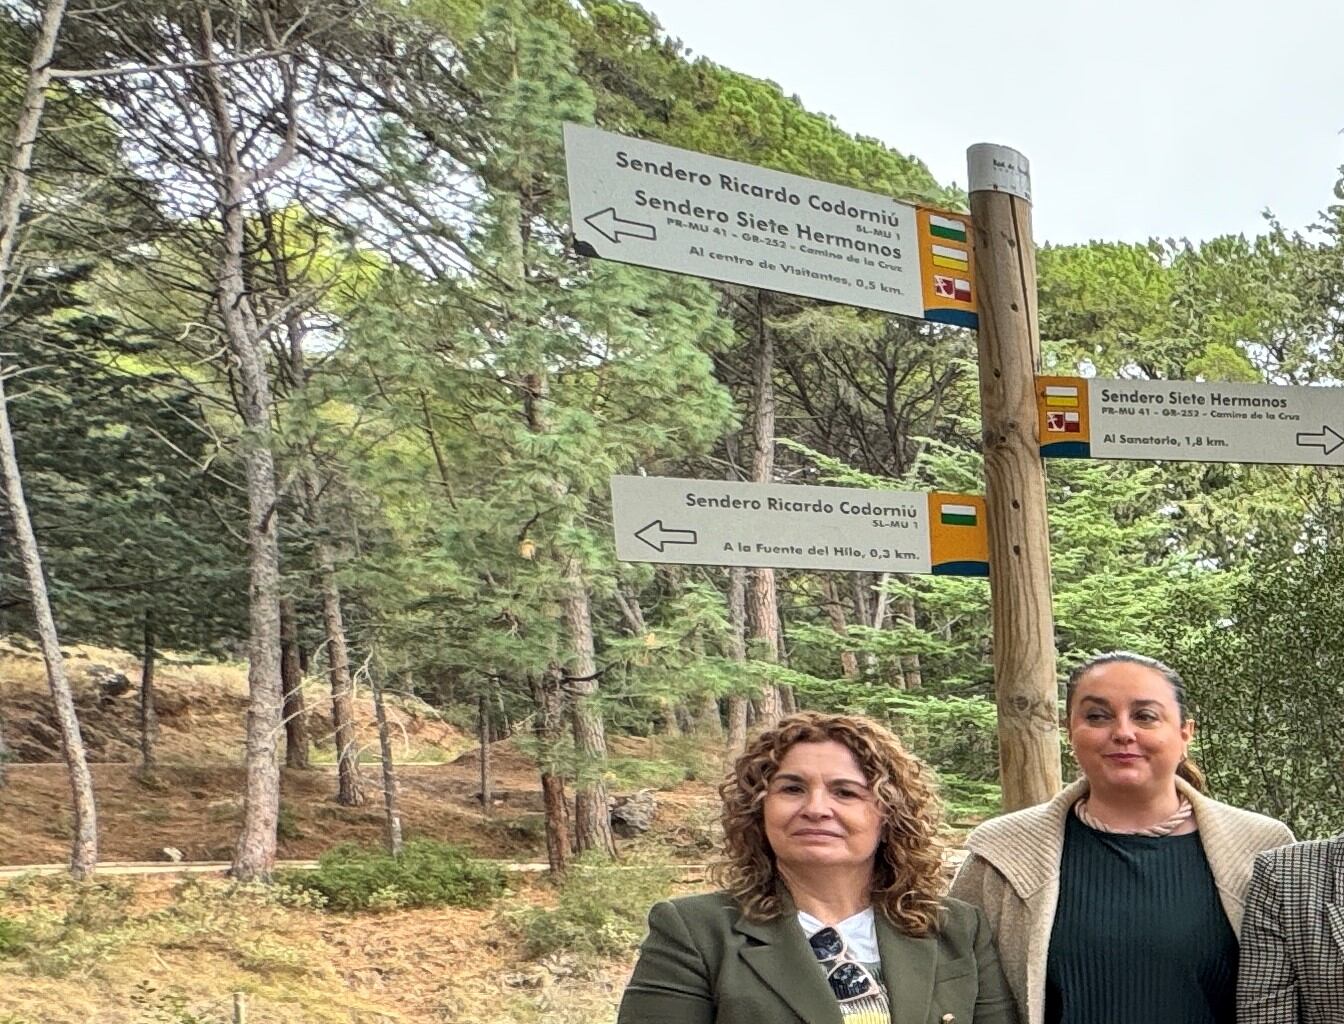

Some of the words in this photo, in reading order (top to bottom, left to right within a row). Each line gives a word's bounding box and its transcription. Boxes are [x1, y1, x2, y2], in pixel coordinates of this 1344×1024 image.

[616, 151, 712, 186] Sendero
[719, 173, 800, 207] Ricardo
[808, 195, 899, 227] Codorniú
[634, 189, 729, 223] Sendero
[736, 210, 789, 236] Siete
[796, 223, 902, 259] Hermanos
[667, 217, 709, 233] PR-MU
[713, 227, 727, 237] 41
[742, 232, 787, 249] GR-252
[799, 244, 843, 260] Camino
[846, 254, 860, 264] de
[864, 257, 875, 267] la
[878, 261, 903, 273] Cruz
[896, 232, 901, 241] 1
[689, 246, 704, 257] Al
[709, 251, 754, 266] centro
[758, 260, 776, 271] de
[780, 263, 852, 287] Visitantes,
[855, 279, 875, 291] 0,5
[880, 283, 904, 296] km.
[1101, 389, 1164, 404] Sendero
[1169, 391, 1206, 405] Siete
[1210, 393, 1287, 408] Hermanos
[1101, 407, 1135, 415] PR-MU
[1138, 408, 1150, 416] 41
[1162, 408, 1199, 417] GR-252
[1210, 410, 1247, 419] Camino
[1250, 411, 1263, 419] de
[1266, 412, 1275, 420] la
[1278, 412, 1300, 421] Cruz
[1103, 434, 1116, 443] Al
[1119, 434, 1181, 447] Sanatorio,
[1185, 436, 1203, 447] 1,8
[1206, 436, 1229, 447] km.
[686, 493, 761, 510] Sendero
[767, 497, 834, 513] Ricardo
[839, 501, 917, 518] Codorniú
[872, 520, 909, 529] SL-MU
[913, 521, 919, 529] 1
[723, 542, 734, 552] A
[738, 542, 751, 553] la
[756, 543, 803, 555] Fuente
[807, 545, 829, 556] del
[833, 547, 866, 559] Hilo,
[894, 549, 920, 560] km.
